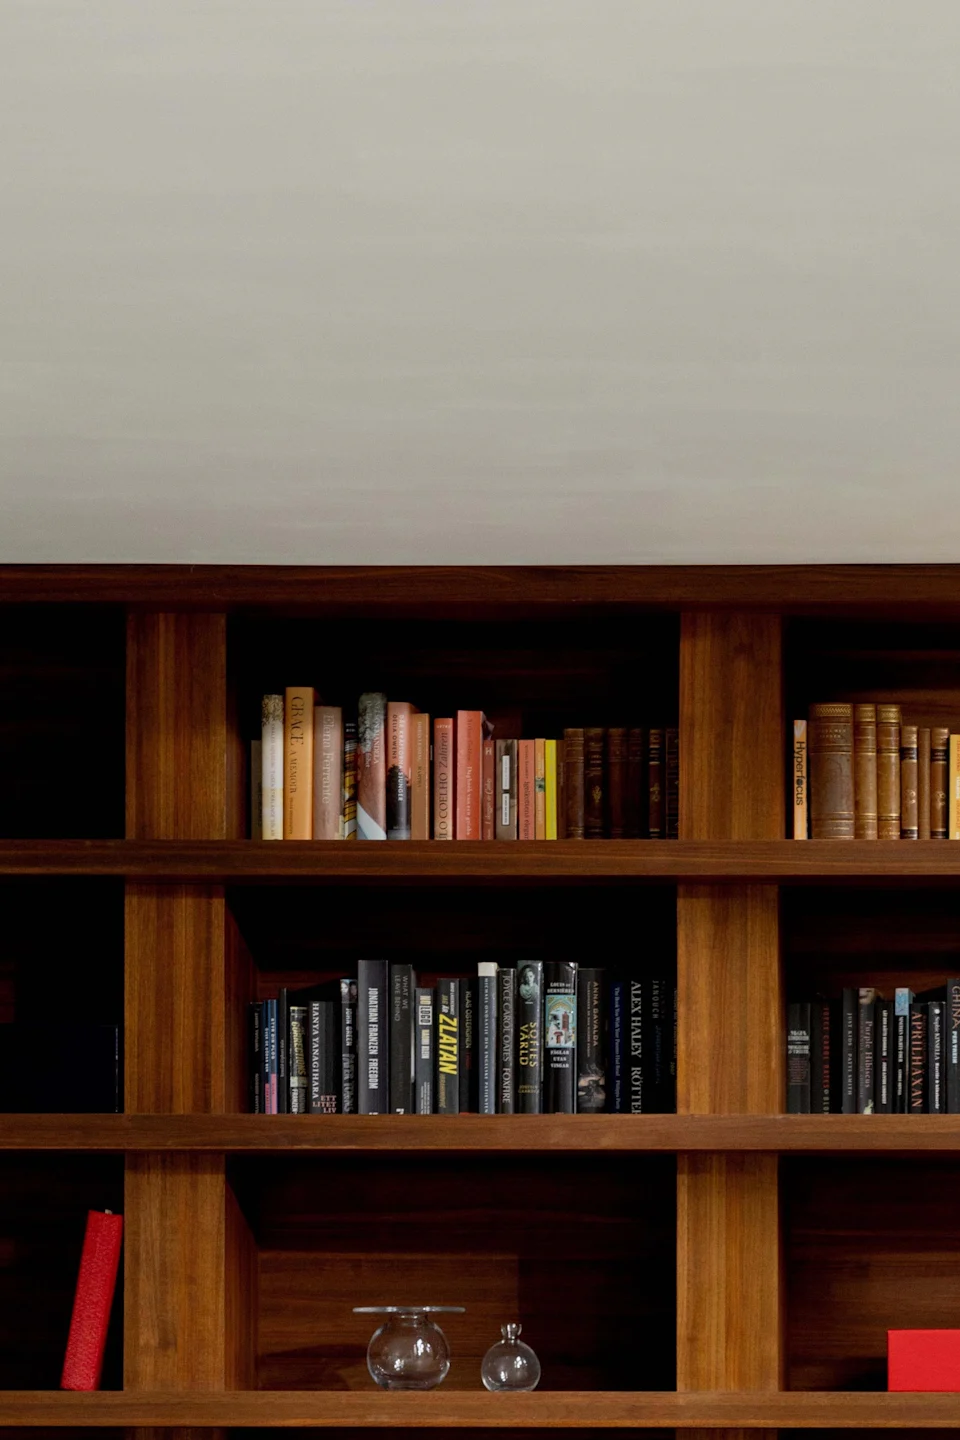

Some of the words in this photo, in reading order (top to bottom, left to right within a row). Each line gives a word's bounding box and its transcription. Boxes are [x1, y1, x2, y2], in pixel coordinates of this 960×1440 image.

[291, 696, 304, 745] GRACE
[322, 715, 335, 747] Elena
[438, 732, 448, 767] Zahiren
[322, 753, 335, 804] Ferrante
[795, 741, 806, 806] Hyperfocus
[439, 773, 448, 817] COELHO
[368, 988, 378, 1022] JONATHAN
[402, 999, 408, 1009] WE
[420, 996, 431, 1004] NO
[502, 976, 512, 1001] JOYCE
[631, 980, 642, 1014] ALEX
[420, 1006, 431, 1024] LOGO
[442, 1004, 449, 1013] ÄR
[502, 1002, 512, 1032] CAROL
[291, 1021, 306, 1076] CORRECTIONS
[368, 1024, 378, 1054] FRANZEN
[439, 1014, 458, 1075] ZLATAN
[502, 1035, 512, 1062] OATES
[520, 1024, 530, 1066] VÄRLD
[530, 1022, 538, 1068] SOFIES
[631, 1016, 642, 1058] HALEY
[864, 1020, 873, 1048] Purple
[368, 1058, 378, 1089] FREEDOM
[865, 1052, 873, 1088] Hibiscus
[912, 1011, 924, 1107] APRILHÄXAN
[502, 1068, 512, 1103] FOXFIRE
